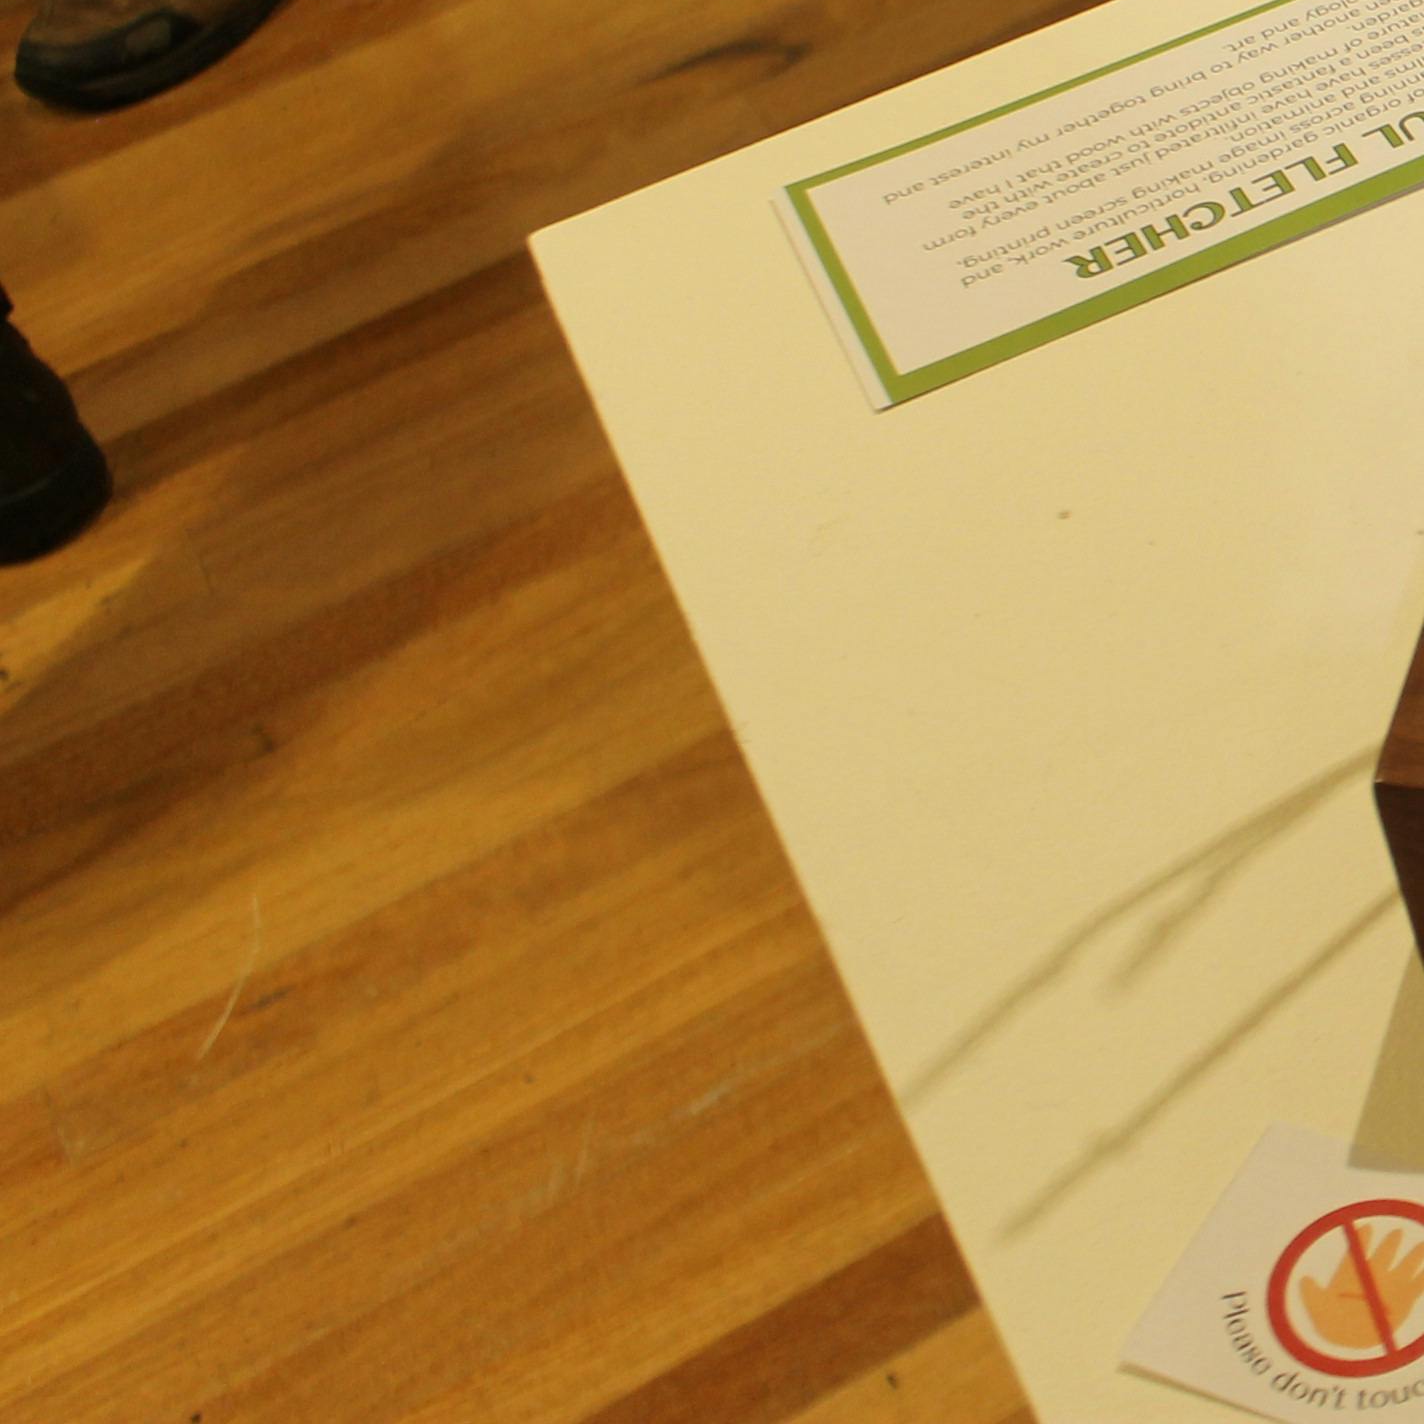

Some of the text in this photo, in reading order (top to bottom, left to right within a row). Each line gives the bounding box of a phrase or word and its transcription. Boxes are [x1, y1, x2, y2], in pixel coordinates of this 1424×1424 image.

[1063, 142, 1360, 279] FLETCHER
[1221, 1290, 1272, 1375] Please
[1270, 1372, 1346, 1411] don't
